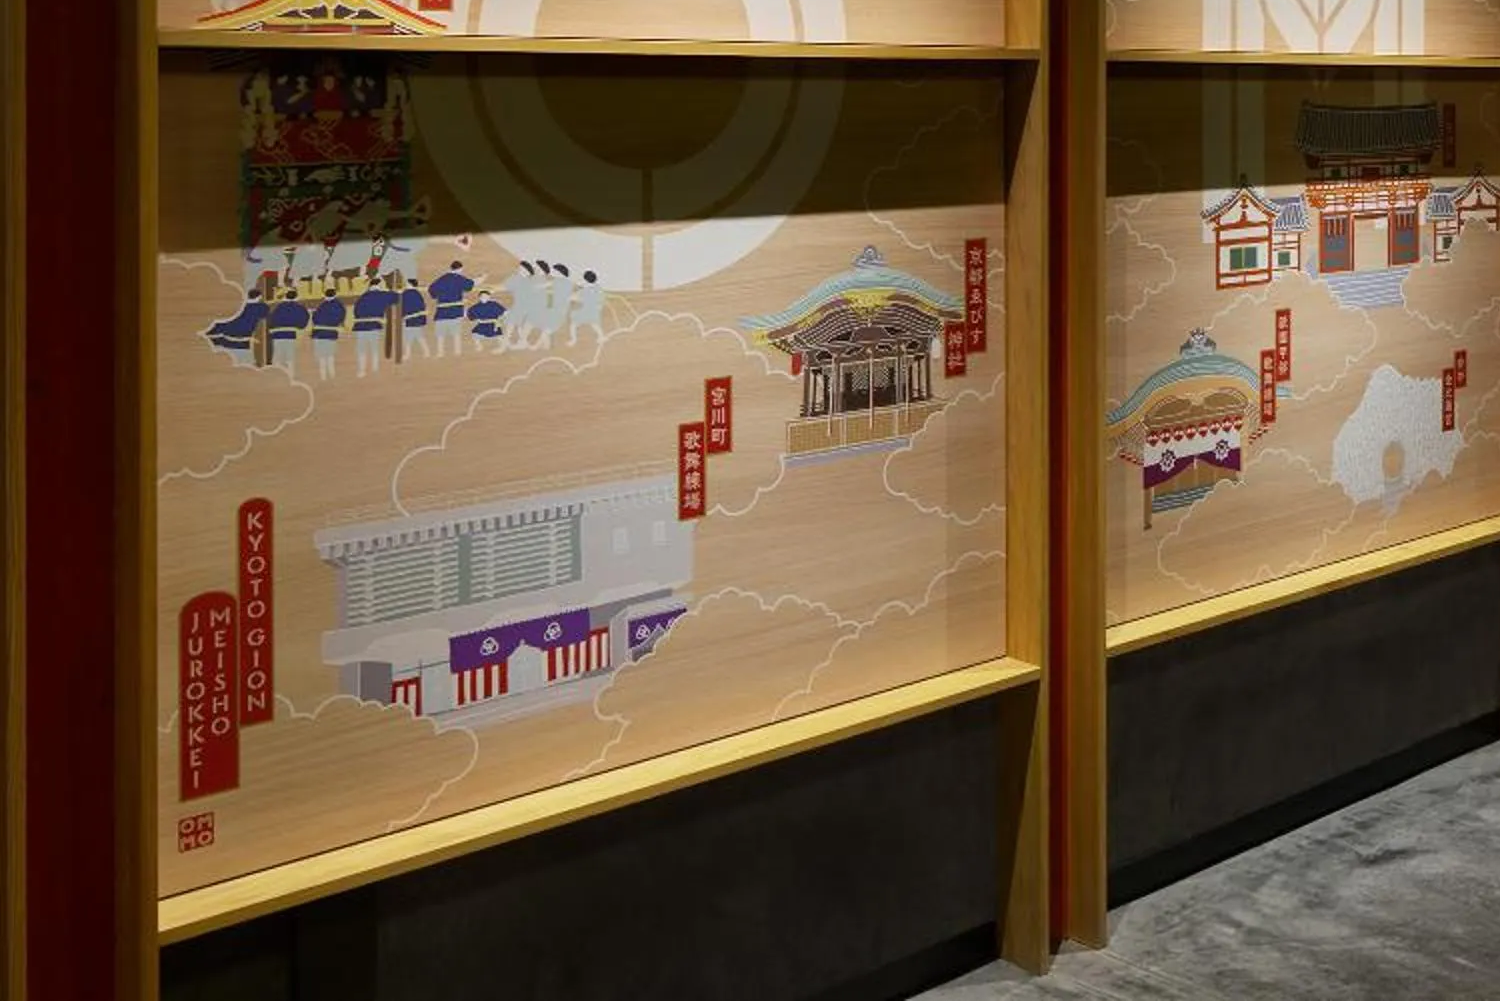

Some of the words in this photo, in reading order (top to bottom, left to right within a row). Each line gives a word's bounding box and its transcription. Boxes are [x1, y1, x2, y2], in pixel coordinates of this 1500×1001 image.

[968, 246, 984, 345] 京都ゑびす
[710, 386, 728, 446] 宮川町
[247, 512, 266, 618] KYOTO
[187, 611, 205, 789] JUROKKEI
[210, 606, 232, 736] MEISHO
[246, 628, 266, 711] GION
